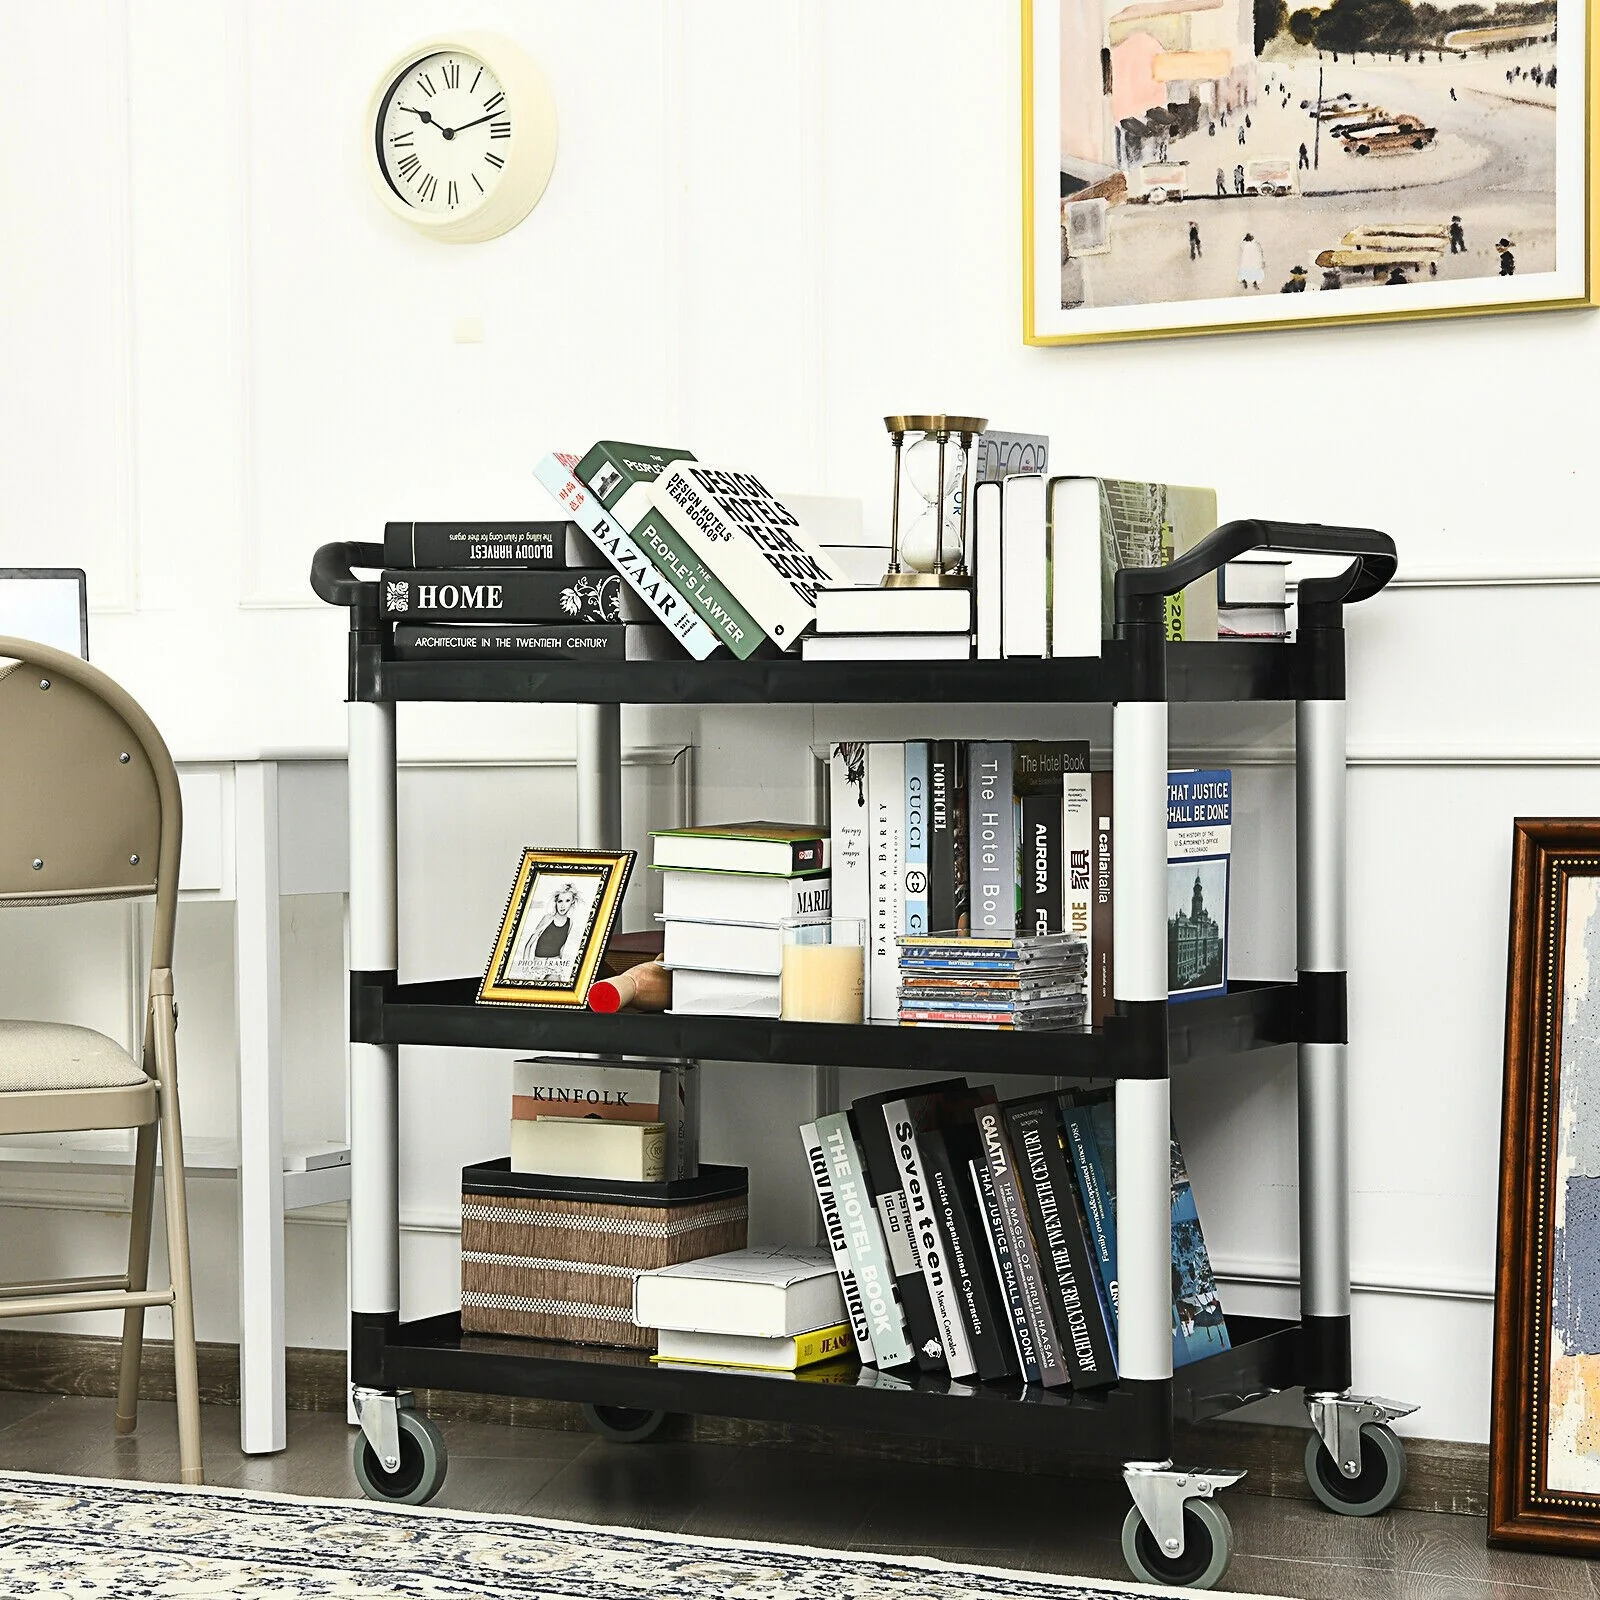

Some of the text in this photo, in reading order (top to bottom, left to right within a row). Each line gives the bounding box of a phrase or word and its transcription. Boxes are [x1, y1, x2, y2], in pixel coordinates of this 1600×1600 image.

[665, 481, 686, 508] YEAR
[670, 472, 701, 508] DESIGN
[688, 467, 774, 499] DESIGN
[713, 496, 800, 527] HOTELS
[469, 544, 553, 560] BLOODY HARVEST
[737, 524, 805, 553] YEAR
[591, 518, 677, 618] BAZAAR
[641, 524, 745, 645] PEOPLE'S LAWYER
[697, 563, 713, 583] THE
[763, 552, 834, 581] BOOK
[417, 585, 504, 609] HOME
[414, 637, 608, 648] ARCHITECTURE IN THE TWENTIETH CENTURY
[981, 760, 998, 801] The
[1020, 753, 1085, 773] The Hotel Book
[933, 763, 947, 833] L'OFFICIEL
[1192, 782, 1229, 800] JUSTICE
[909, 776, 922, 850] GUCCI
[1194, 805, 1206, 821] BE
[1207, 803, 1229, 820] DONE
[982, 813, 999, 873] Hotel
[1035, 823, 1048, 894] AURORA
[846, 860, 856, 868] the
[877, 803, 888, 956] BARBERA BAREY
[1098, 833, 1111, 904] caliaitalia
[532, 1086, 630, 1107] KINFOLK
[1023, 1129, 1050, 1181] CENTURY
[1071, 1122, 1110, 1263] Family owned&operated since 1983
[824, 1129, 894, 1337] THE HOTEL BOOK
[882, 1194, 900, 1234] IGLOO
[1035, 1181, 1067, 1248] TWENTIETH
[894, 1121, 926, 1210] Seven
[917, 1214, 945, 1288] teen
[942, 1319, 957, 1358] Concealers
[934, 1171, 983, 1337] Unicist Organizational Cybernetics
[980, 1114, 1056, 1368] GALATTA THE MAGIC OF SHRUTI HAASAN
[979, 1166, 1038, 1366] THAT JUSTICE SHALL BE DONE
[1051, 1248, 1073, 1273] THE
[1057, 1273, 1077, 1287] IN
[1061, 1286, 1098, 1373] ARCHITECYURE
